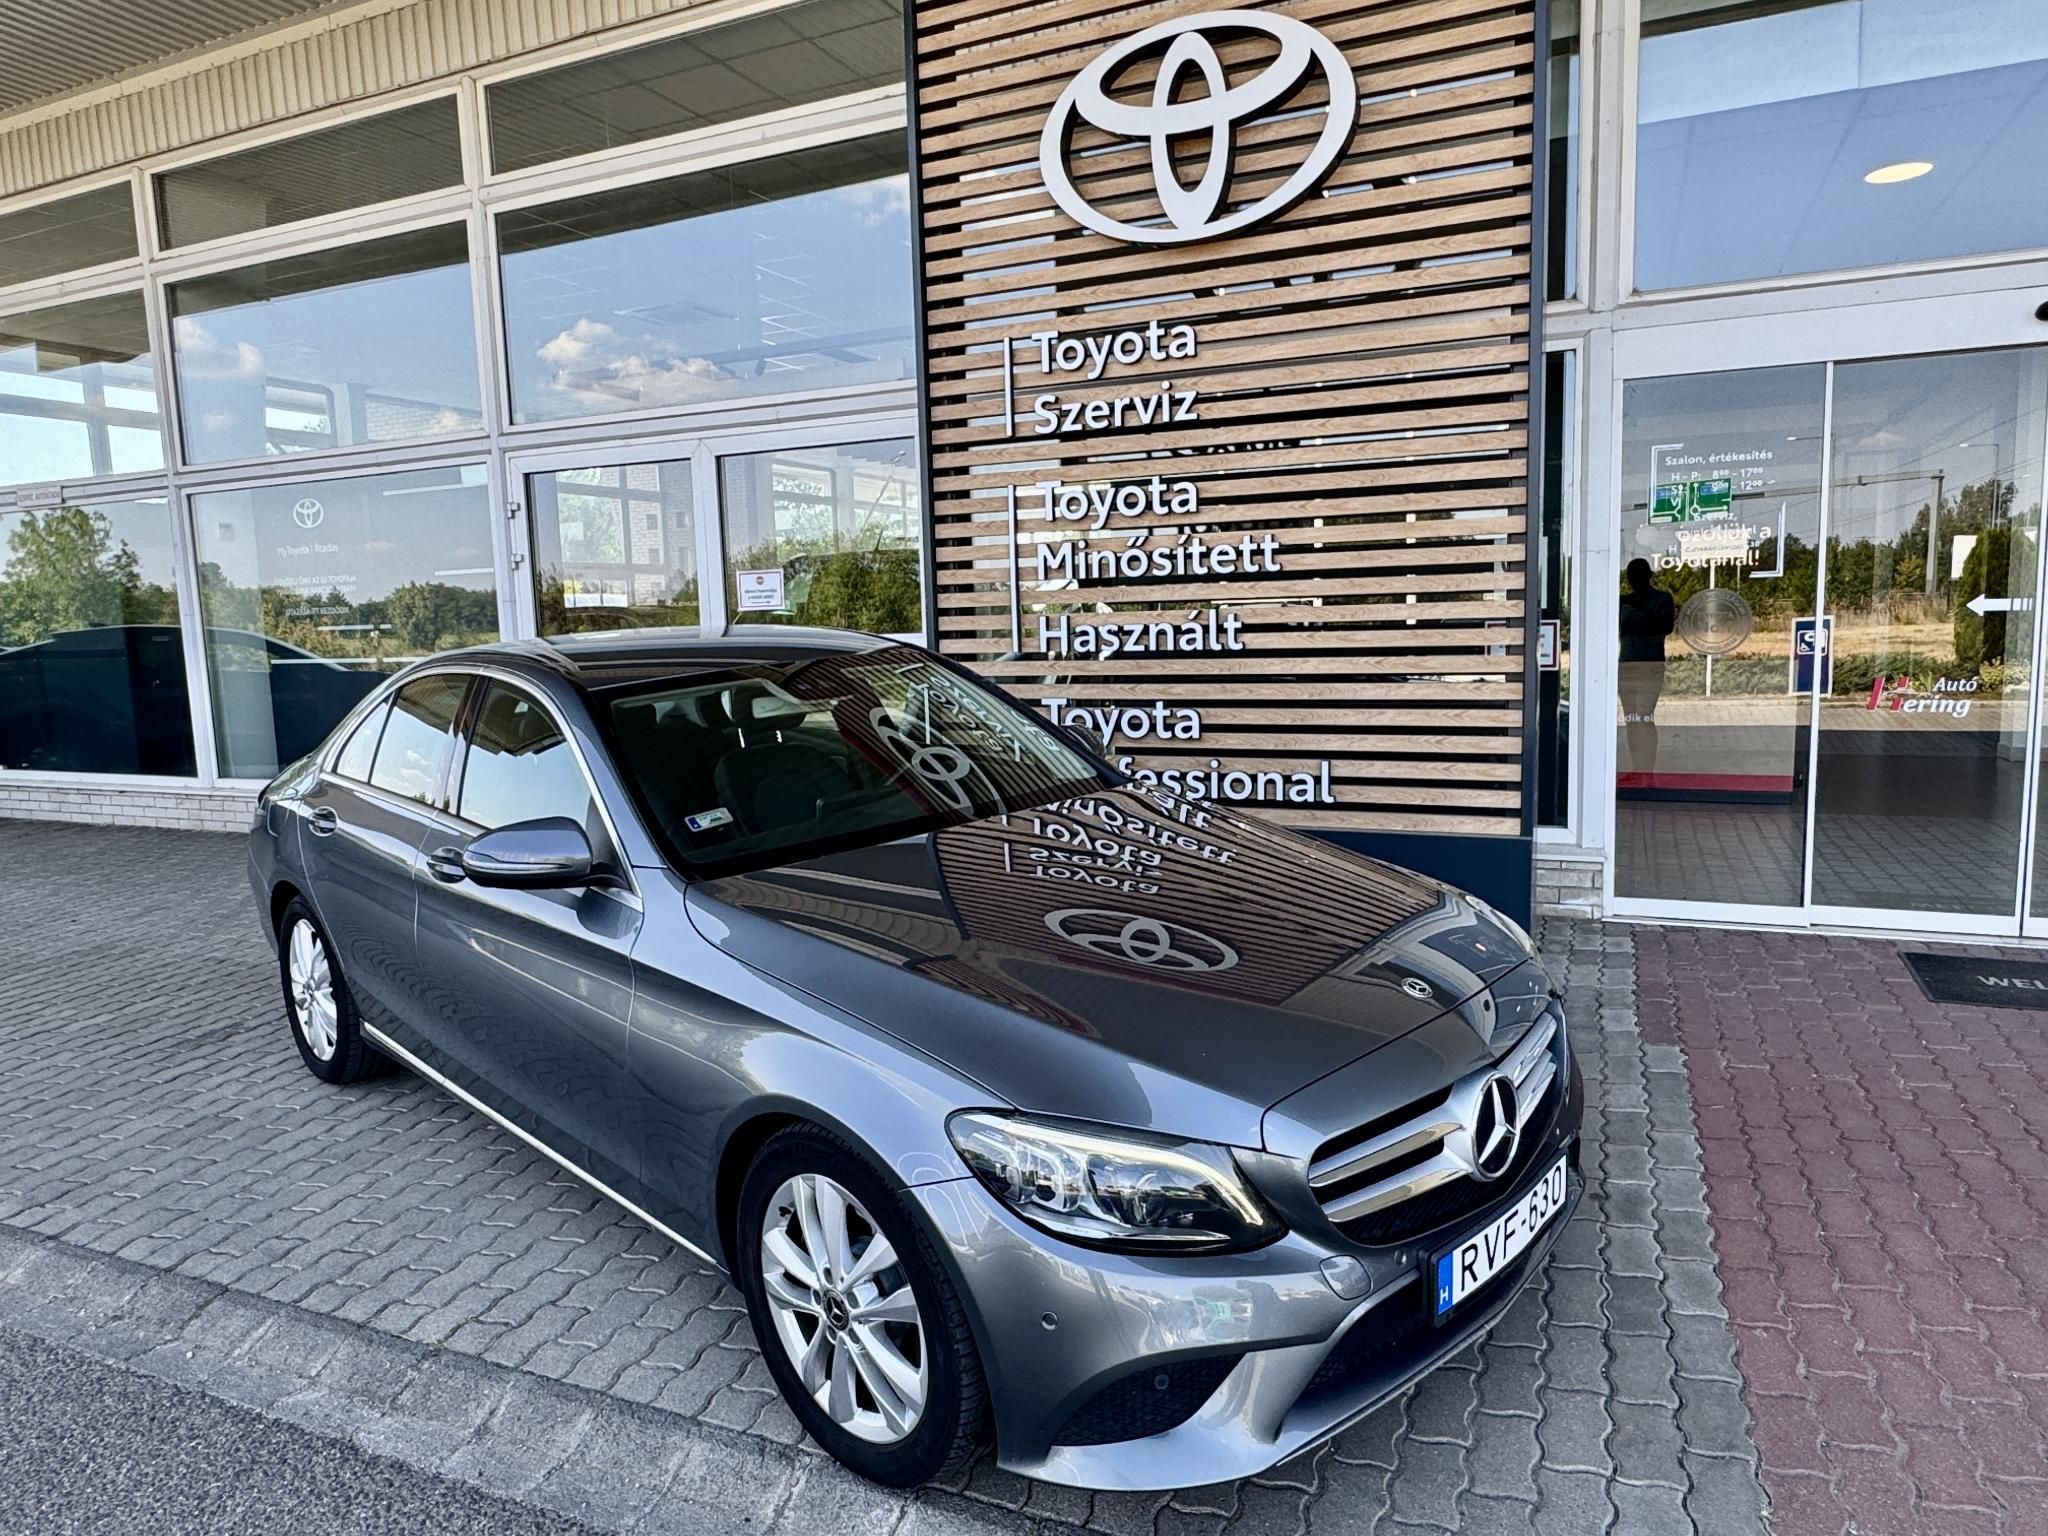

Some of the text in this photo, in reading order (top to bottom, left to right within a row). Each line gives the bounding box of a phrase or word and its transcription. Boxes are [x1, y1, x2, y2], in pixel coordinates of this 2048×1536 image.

[1031, 320, 1198, 379] Toyota
[1033, 381, 1200, 434] Szerviz
[1035, 475, 1199, 530] Toyota
[1037, 533, 1282, 581] Minősített
[1039, 609, 1245, 654] Használt
[1866, 676, 1972, 718] Hering
[1932, 675, 1980, 692] Autó
[1041, 698, 1201, 746] Toyota
[1117, 755, 1335, 804] fessional
[1460, 1164, 1563, 1292] RVF-630
